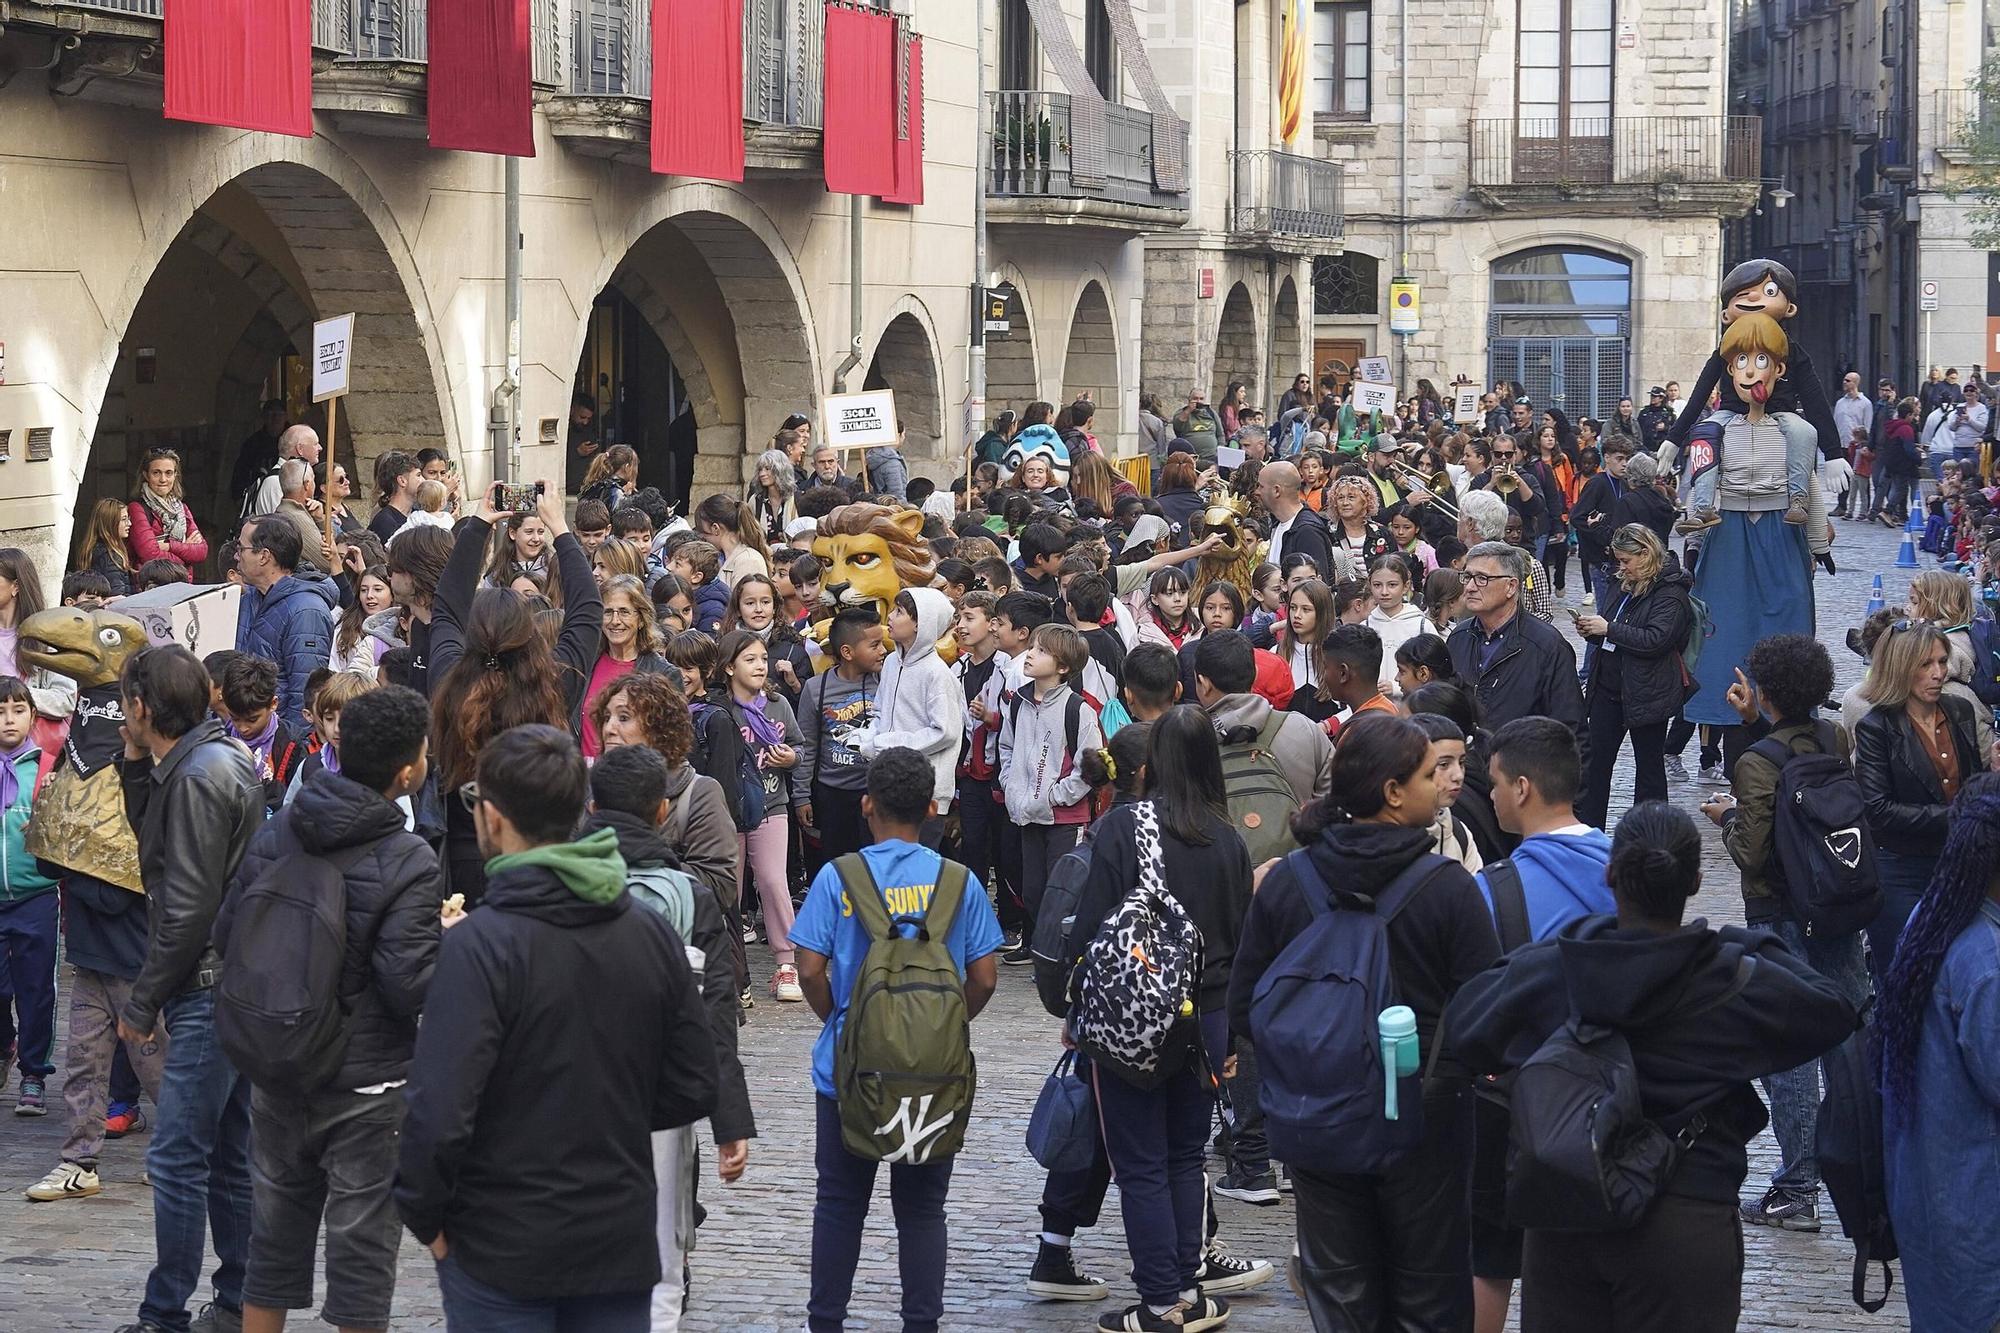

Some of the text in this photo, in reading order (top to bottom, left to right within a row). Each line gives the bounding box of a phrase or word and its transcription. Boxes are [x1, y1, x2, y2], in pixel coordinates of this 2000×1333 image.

[842, 407, 876, 419] ESCOLA
[840, 419, 881, 432] EIXIMENIS
[832, 752, 855, 766] RACE
